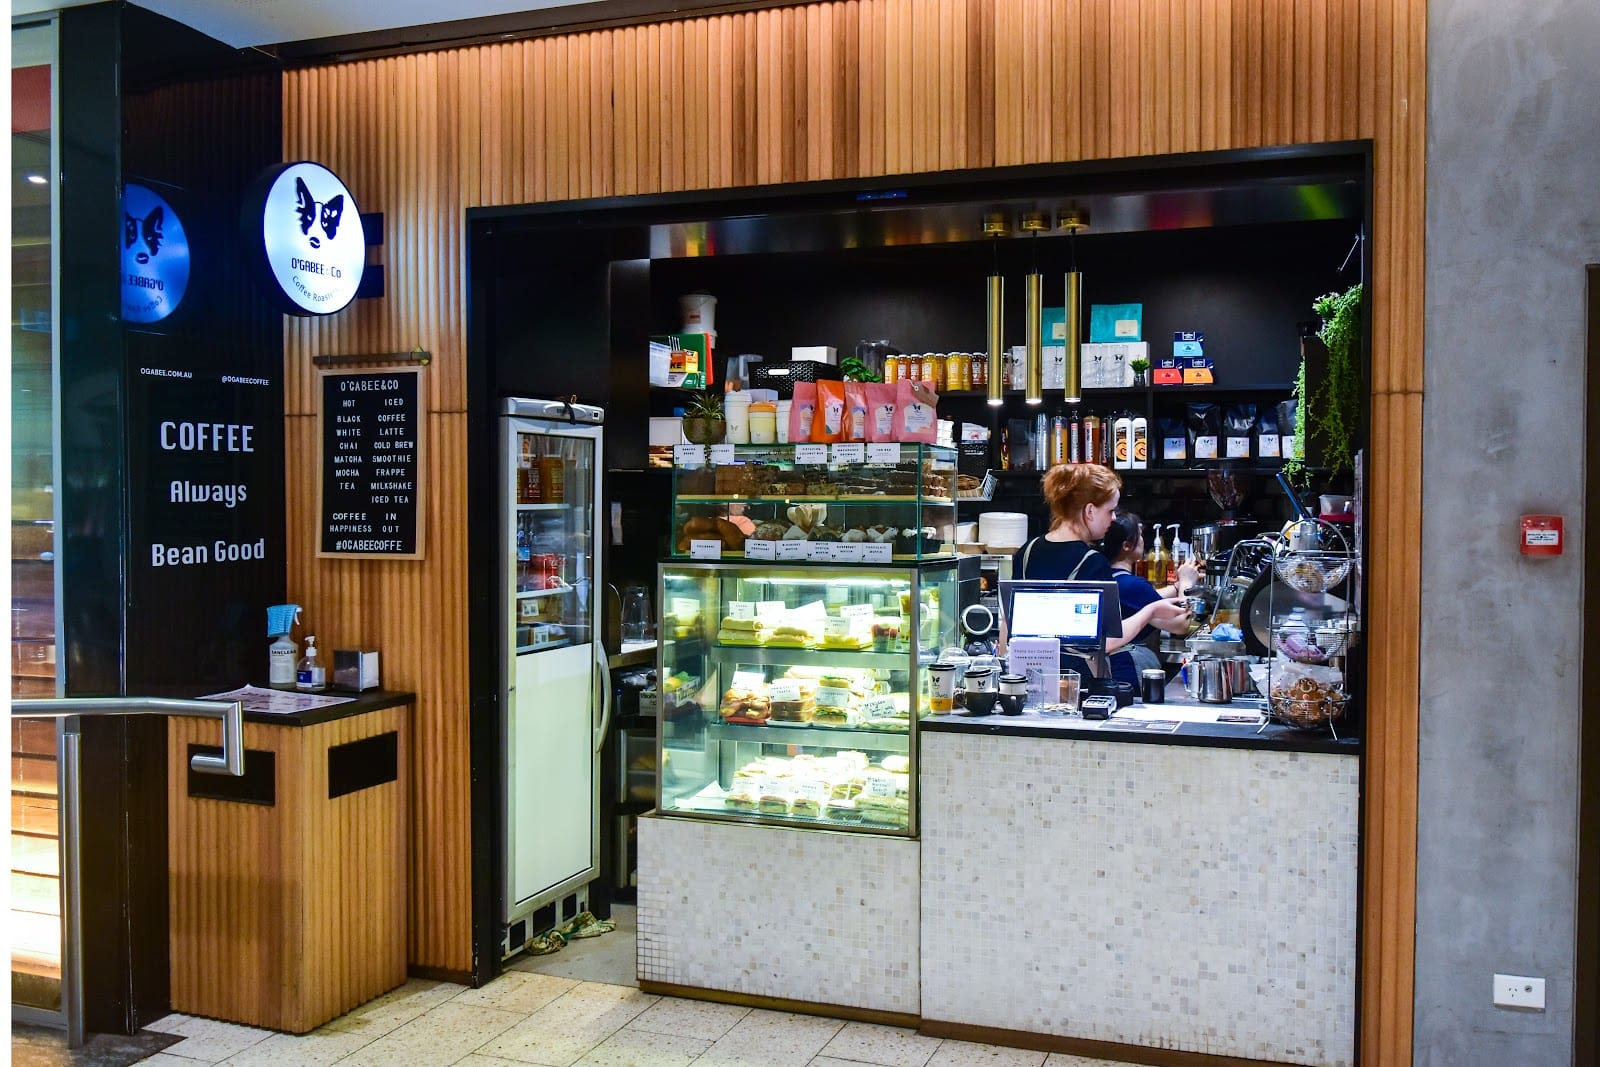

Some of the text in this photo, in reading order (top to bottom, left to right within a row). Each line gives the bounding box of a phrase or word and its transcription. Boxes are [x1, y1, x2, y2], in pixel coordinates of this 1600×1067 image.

[291, 257, 324, 275] O'GABEE
[331, 266, 342, 278] Co
[292, 275, 311, 299] Coffee
[140, 368, 192, 378] OGABEE.COM.AU
[222, 376, 270, 386] @OGABEECOFFEE
[342, 400, 356, 408] HOT
[378, 414, 406, 422] COFFEE
[336, 428, 360, 436] WHITE
[380, 428, 404, 436] LATTE
[161, 422, 254, 451] COFFEE
[340, 442, 358, 450] CHAI
[394, 440, 414, 448] BREW
[334, 456, 362, 464] MATCHA
[372, 454, 410, 462] SMOOTHIE
[336, 468, 360, 476] MOCHA
[376, 468, 404, 476] FRAPPE
[370, 482, 412, 490] MILKSHAKE
[171, 481, 246, 507] Always
[372, 496, 408, 504] ICED TEA
[332, 512, 396, 520] COFFEE IN
[330, 524, 372, 532] HAPPINESS
[152, 538, 264, 566] Bean Good
